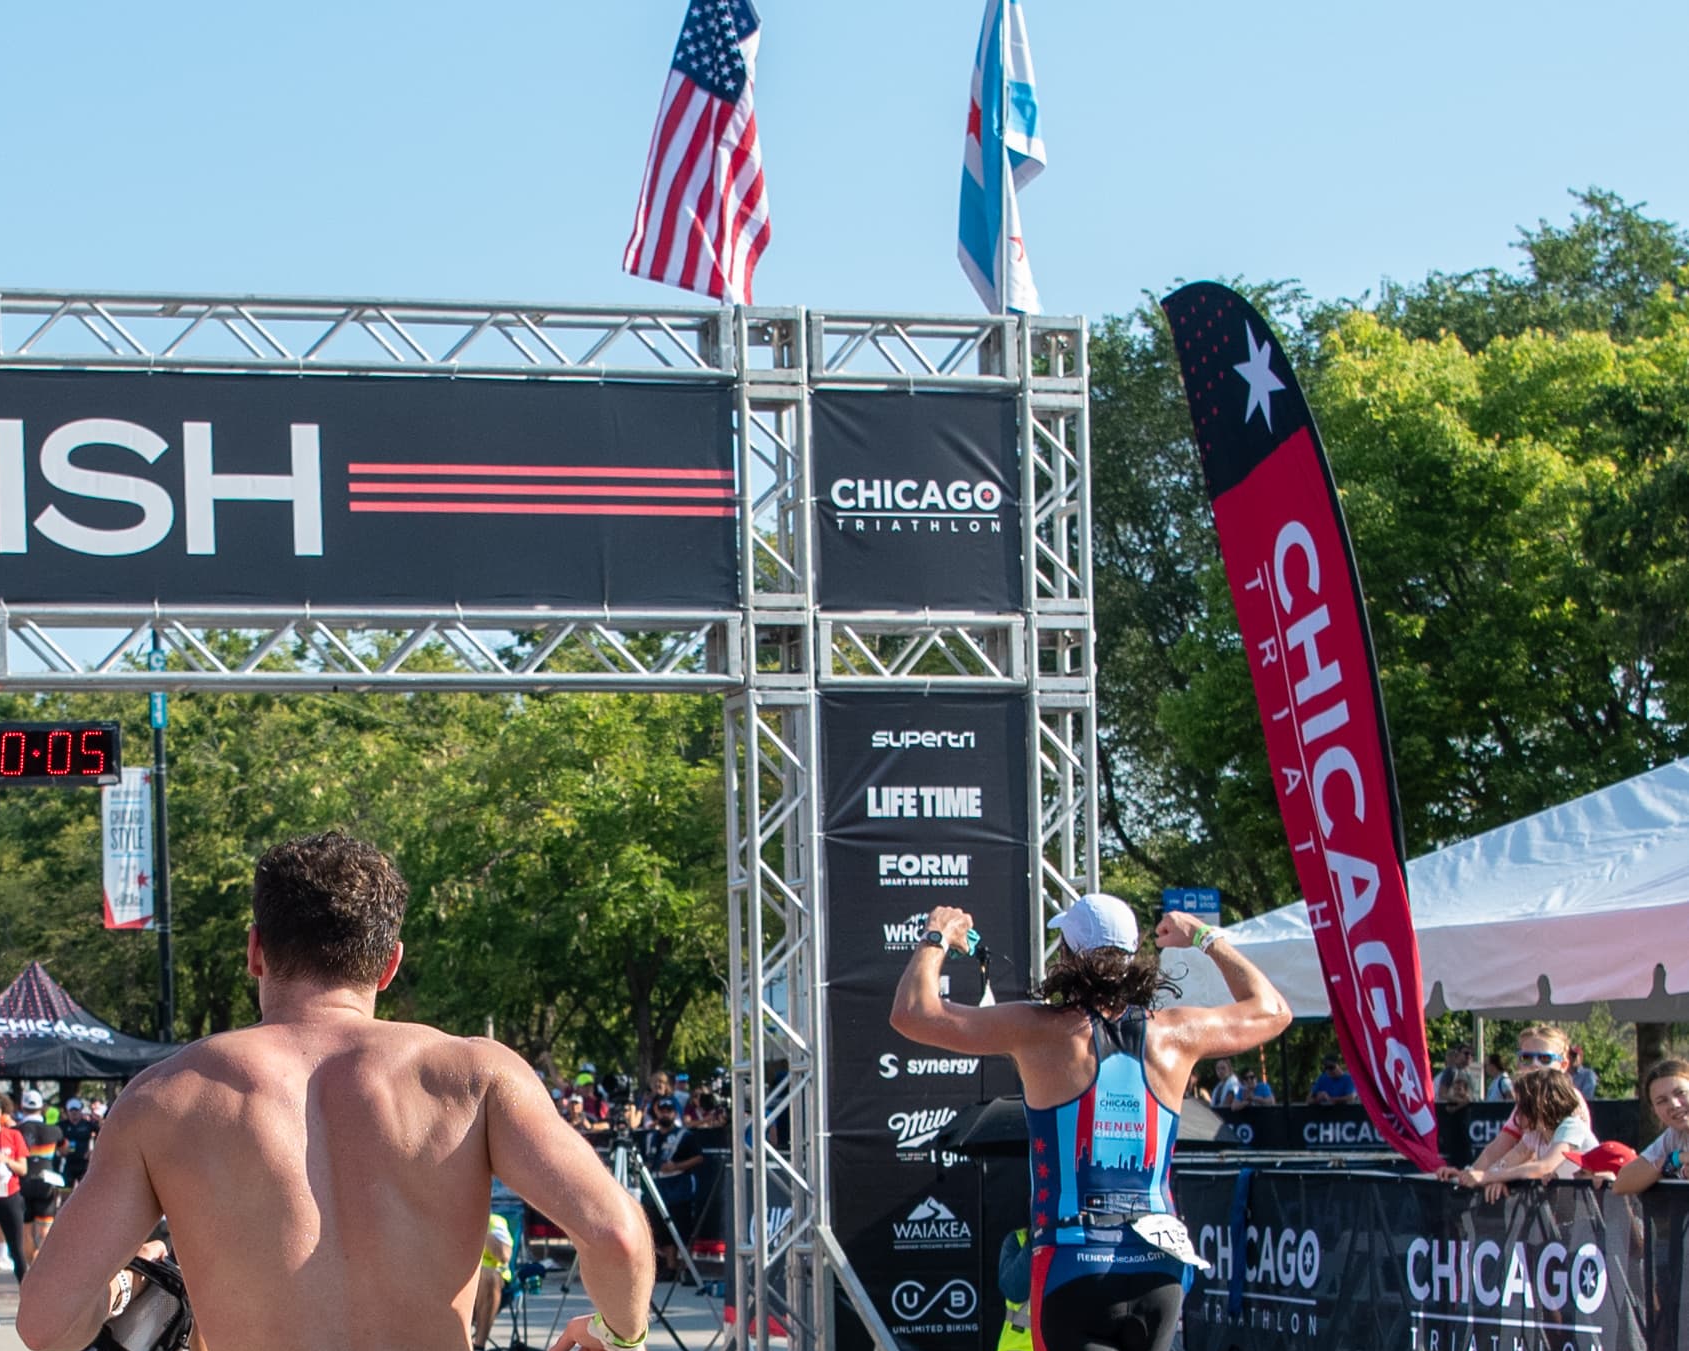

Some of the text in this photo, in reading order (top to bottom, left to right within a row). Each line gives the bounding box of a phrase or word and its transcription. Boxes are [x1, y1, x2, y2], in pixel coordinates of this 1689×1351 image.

[831, 478, 1002, 511] CHICAGO
[836, 519, 1001, 532] TRIATHLON
[867, 787, 983, 818] LIFE TIME
[111, 828, 144, 850] STYLE
[880, 878, 906, 886] SMART
[908, 878, 930, 886] SWIM
[907, 1058, 980, 1075] synergy
[1094, 1121, 1145, 1132] RENEW
[1199, 1223, 1320, 1289] CHCAGO
[1407, 1237, 1608, 1315] CHICAGO
[892, 1323, 979, 1334] UNLIMITED BIKING
